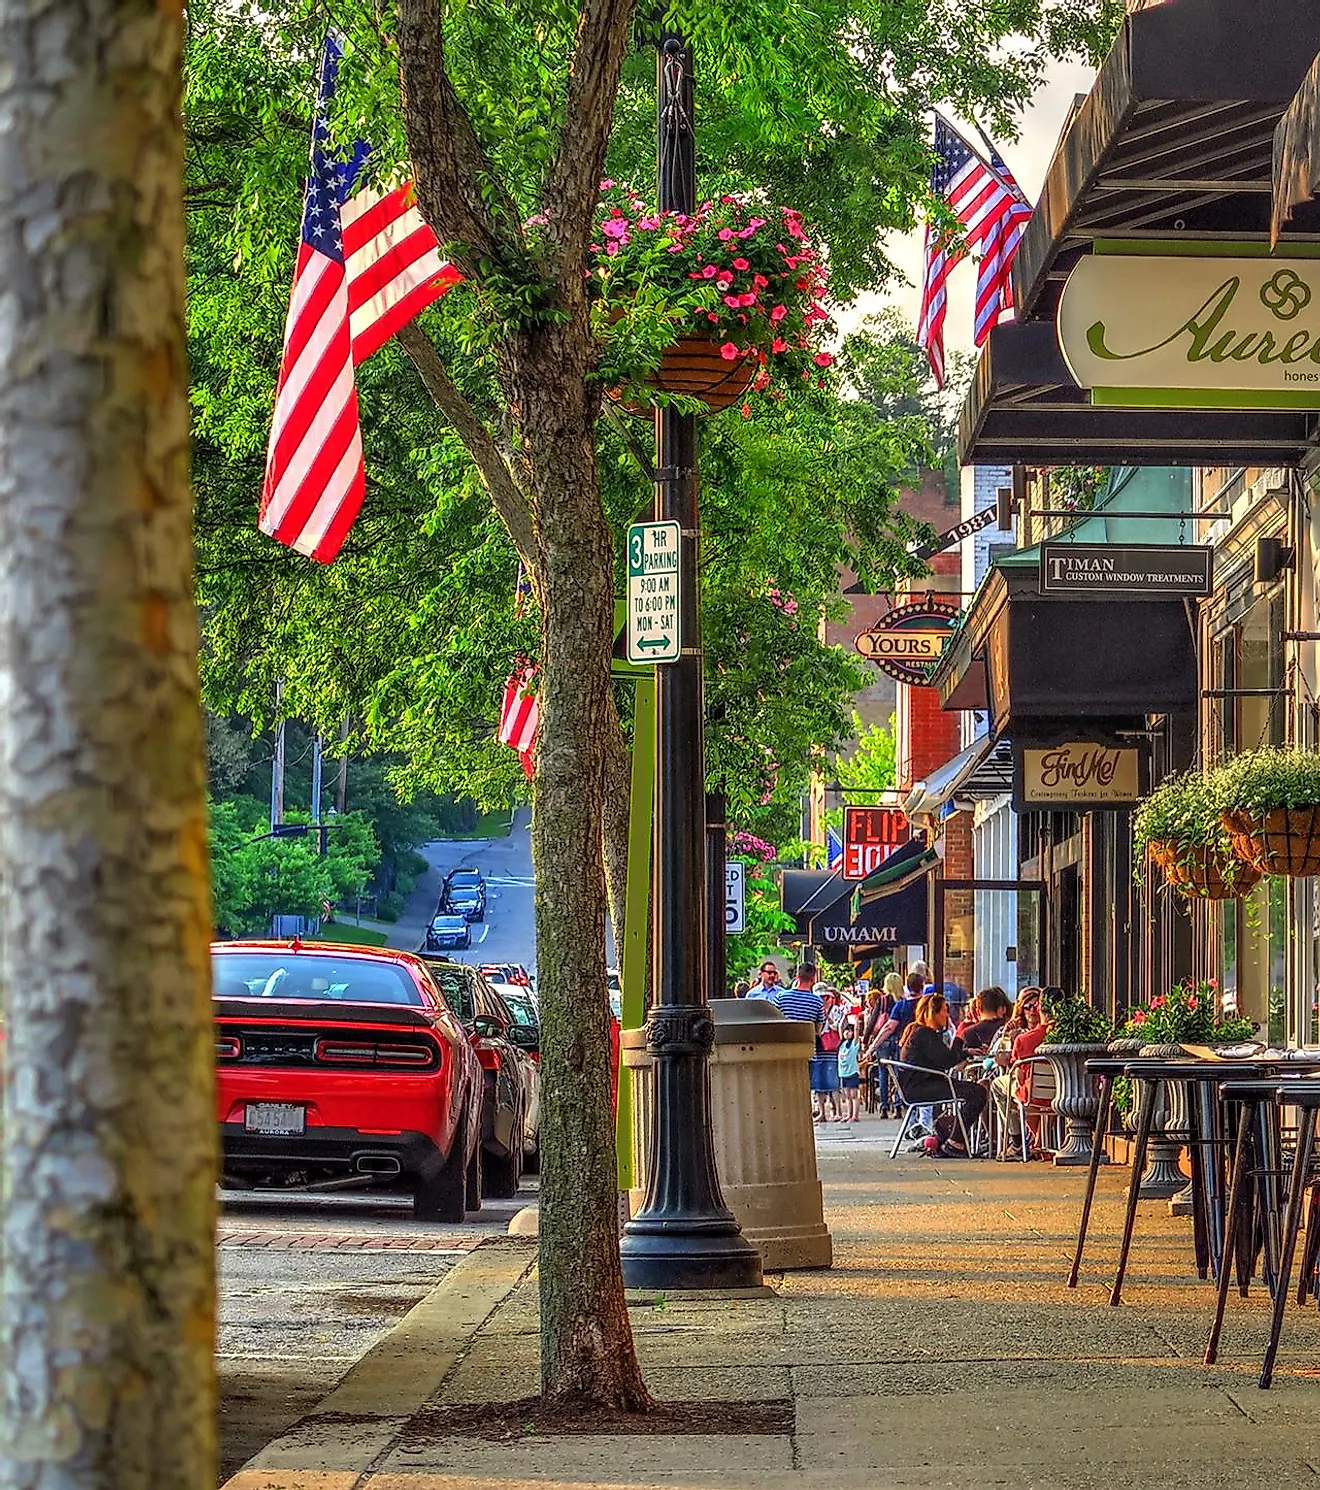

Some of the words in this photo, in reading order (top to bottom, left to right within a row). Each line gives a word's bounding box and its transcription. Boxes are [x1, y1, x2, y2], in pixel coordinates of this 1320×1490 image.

[947, 509, 996, 542] 1981
[653, 530, 667, 548] HR
[630, 535, 642, 569] 3
[644, 551, 677, 570] PARKING
[1049, 557, 1115, 580] TIMAN
[1065, 571, 1103, 582] CUSTOM
[1105, 572, 1145, 583] WINDOW
[1147, 573, 1204, 584] TREATMENTS
[640, 578, 657, 593] 9:00
[659, 577, 670, 592] AM
[634, 597, 643, 612] TO
[645, 596, 663, 611] 6:00
[665, 595, 676, 610] PM
[636, 616, 653, 631] MON
[660, 614, 674, 629] SAT
[867, 634, 931, 654] YOURS
[851, 811, 908, 843] FLIP
[824, 926, 897, 942] UMAMI
